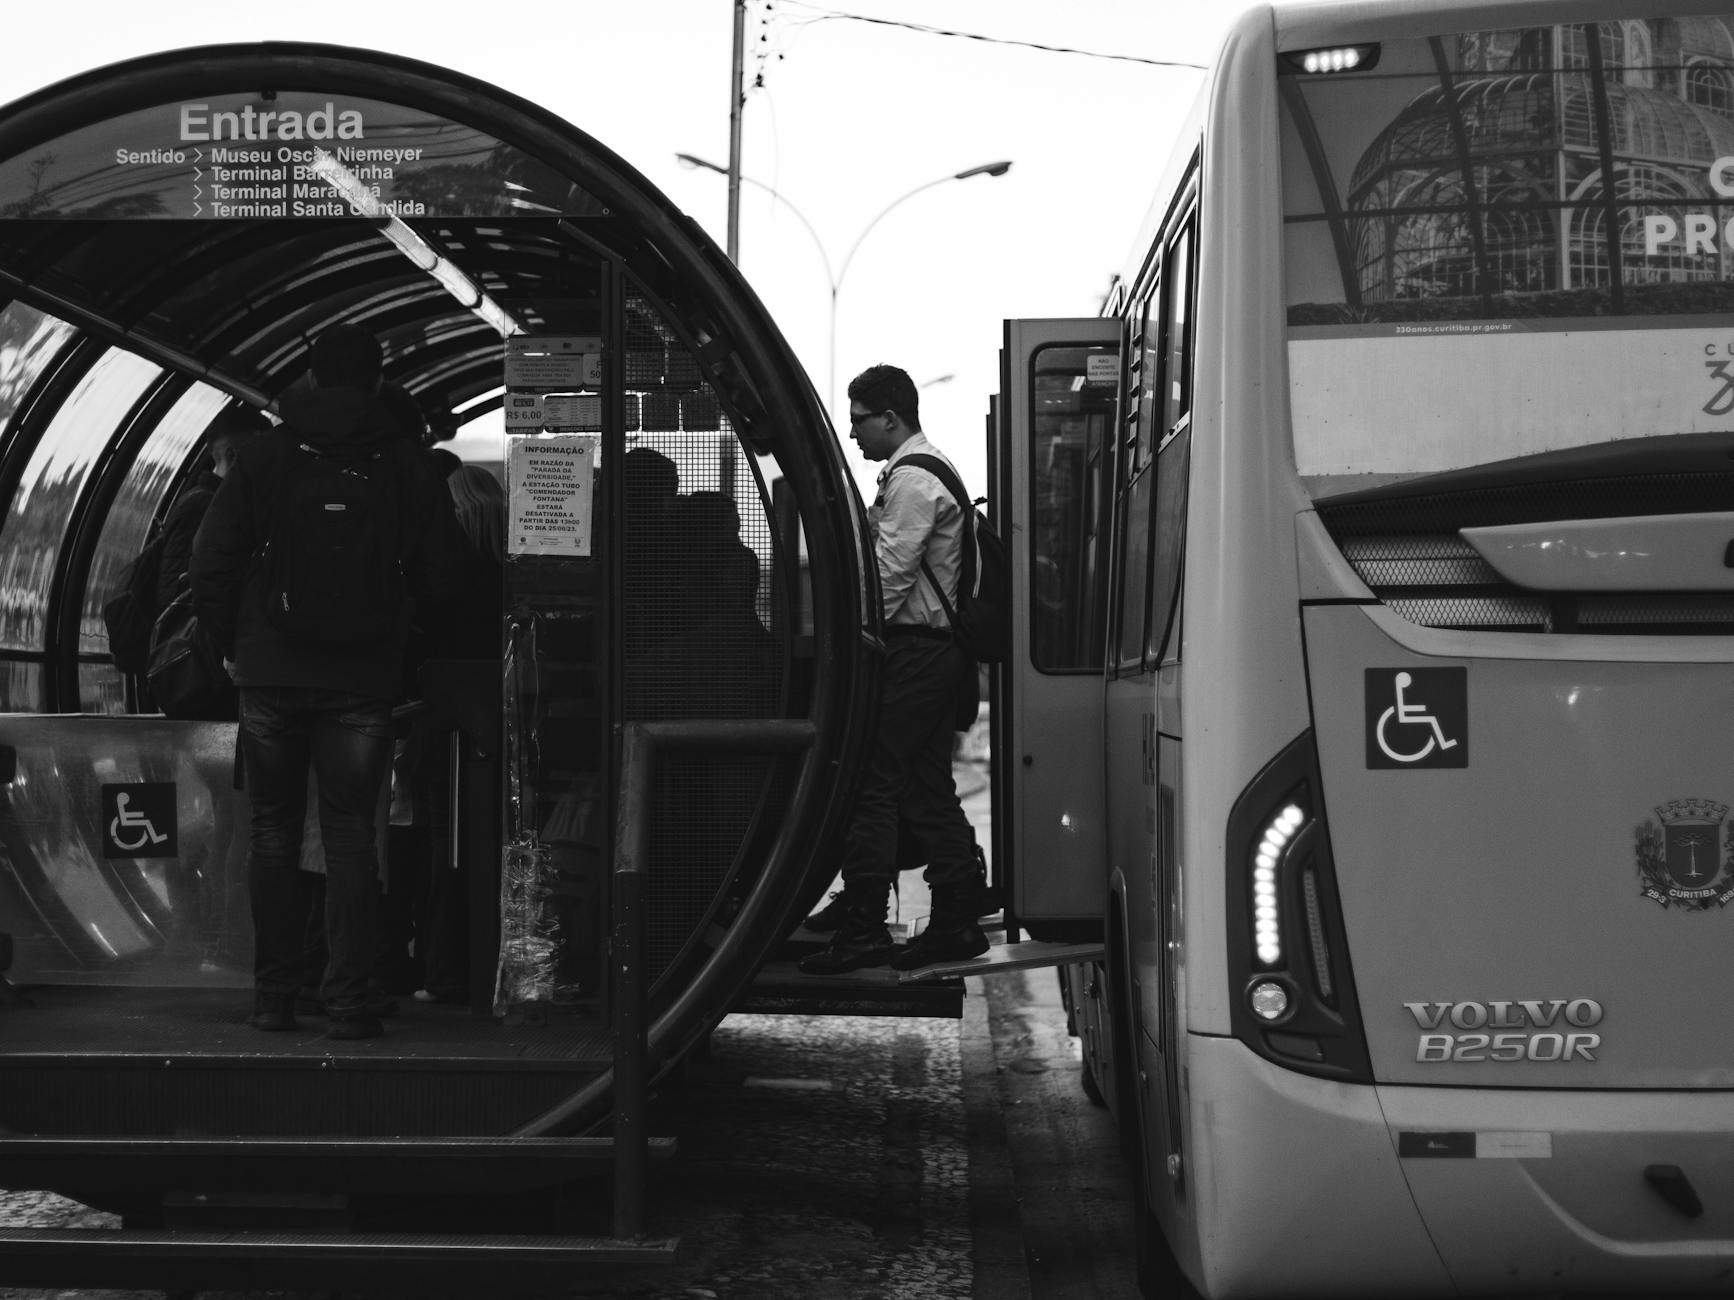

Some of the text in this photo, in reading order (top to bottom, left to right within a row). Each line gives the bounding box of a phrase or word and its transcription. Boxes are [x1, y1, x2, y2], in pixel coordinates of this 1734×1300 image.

[180, 102, 364, 141] Entrada
[116, 146, 423, 164] Sentido Museu Oscar Niemeyer
[211, 166, 287, 181] Terminal
[211, 184, 287, 200] Terminal
[211, 200, 425, 217] Terminal Santa Cndida
[1645, 213, 1734, 256] PR
[525, 445, 585, 455] INFORMAÇÃO
[541, 459, 563, 467] RAZÃO
[529, 481, 560, 489] ESTAÇÃO
[525, 510, 567, 518] DESATIVADA
[1669, 888, 1718, 899] CURITIBA
[1720, 887, 1734, 904] 169
[1403, 999, 1604, 1030] VOLVO
[1415, 1033, 1601, 1063] B250R
